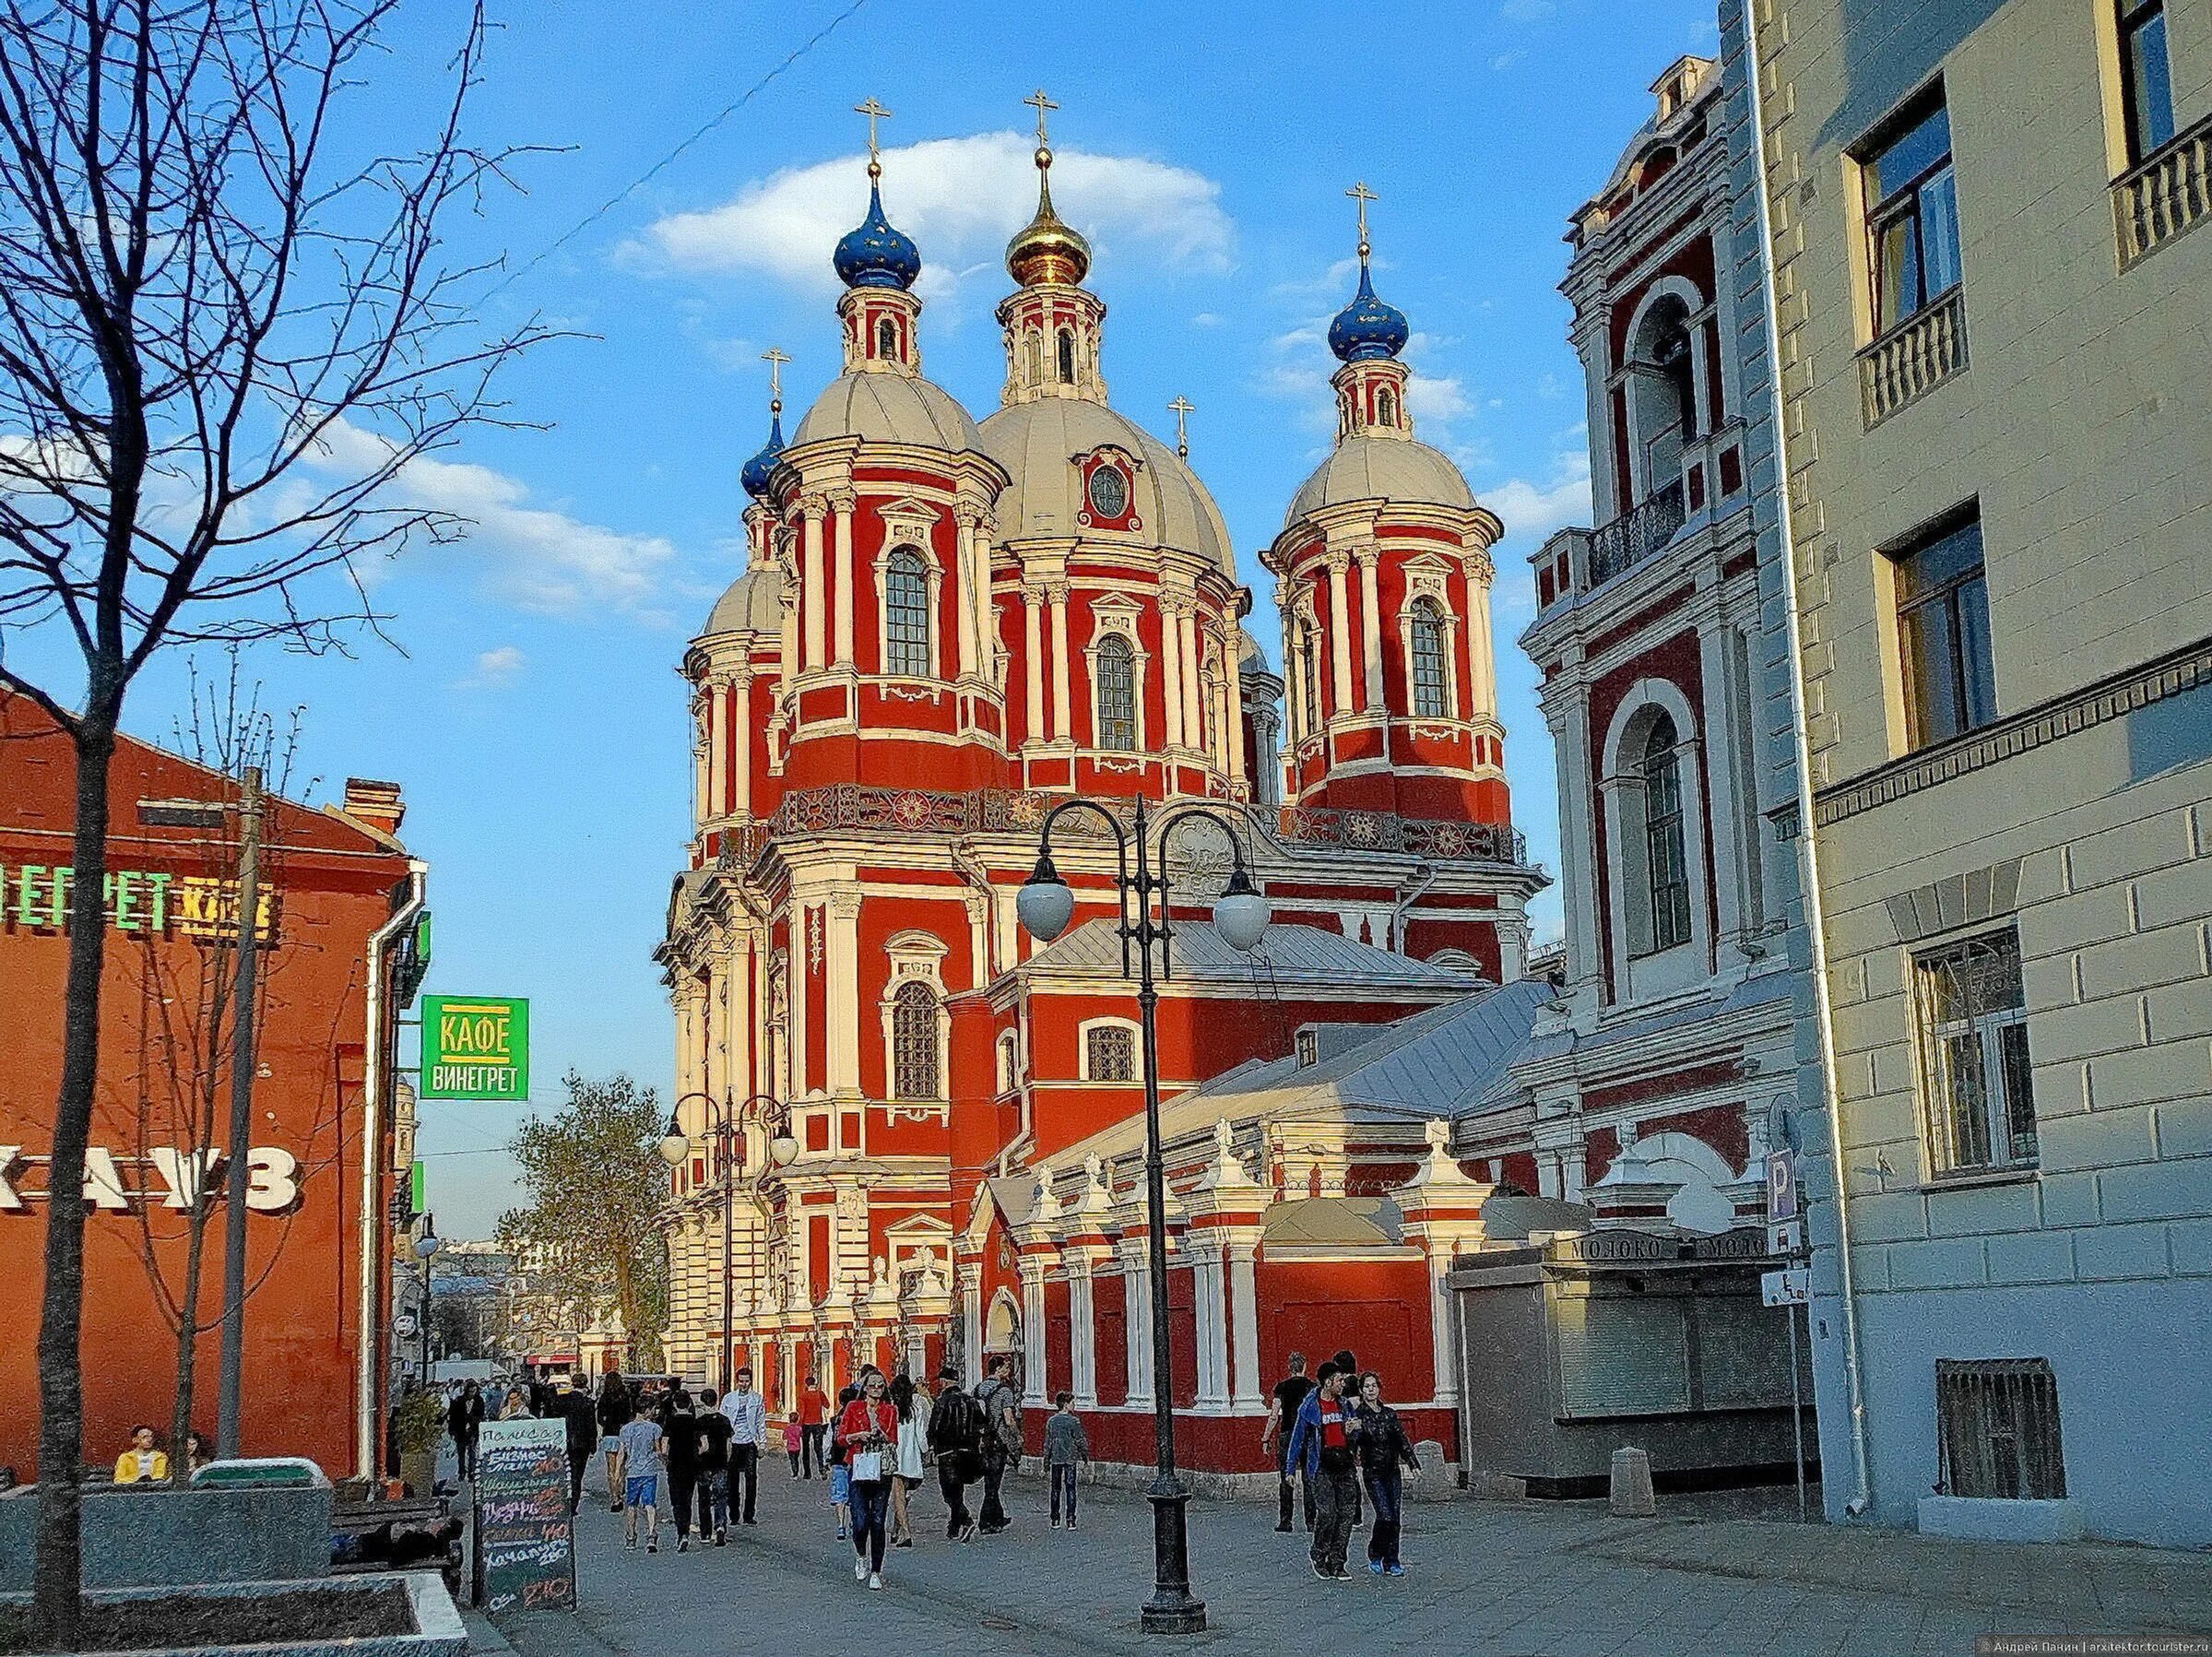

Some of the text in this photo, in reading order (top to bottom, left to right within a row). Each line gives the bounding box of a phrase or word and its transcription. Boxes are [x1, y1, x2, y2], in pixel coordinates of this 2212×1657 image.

[441, 1016, 509, 1052] КАФЕ
[432, 1065, 518, 1092] ВИНЕГРЕТ
[1772, 1160, 1788, 1213] P
[1571, 1239, 1661, 1259] МОЛОКО
